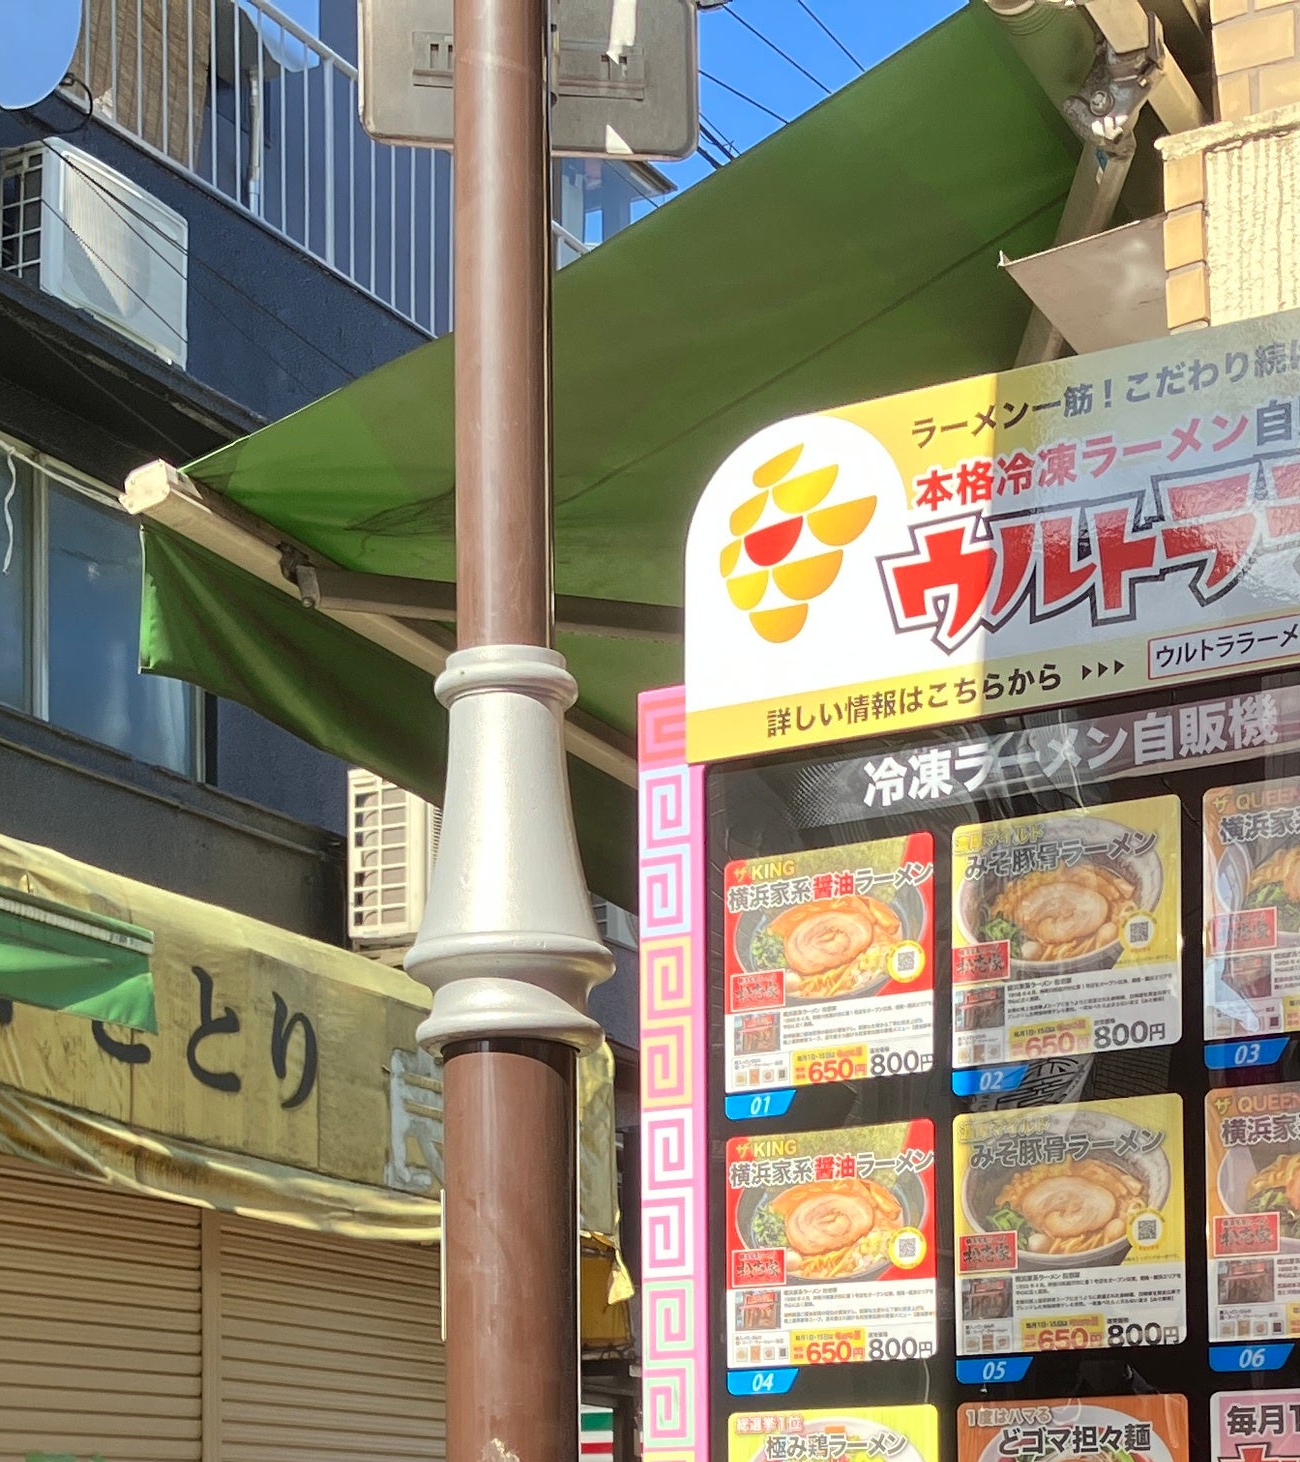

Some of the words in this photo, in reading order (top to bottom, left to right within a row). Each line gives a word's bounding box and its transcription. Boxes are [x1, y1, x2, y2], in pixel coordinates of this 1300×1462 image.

[765, 663, 1061, 738] 詳しい情報はこちらから
[863, 694, 1278, 807] 冷凍ラーメン自販機
[955, 824, 1044, 852] マイルド
[964, 831, 1158, 881] みそ豚骨ラーメン
[752, 860, 796, 881] KING
[728, 862, 934, 912] 横浜家系醤油ラーメン
[1094, 1020, 1166, 1049] 800円
[870, 1050, 934, 1076] 800円
[1234, 1044, 1260, 1065] 03
[979, 1071, 1004, 1091] 02
[750, 1096, 771, 1115] 01
[753, 1140, 797, 1158] KING
[970, 1129, 1166, 1169] みそ豚骨ラーメン
[730, 1149, 935, 1188] 横浜家系醤油ラーメン
[1107, 1322, 1179, 1347] 800円
[869, 1337, 933, 1361] 800円
[1238, 1347, 1265, 1368] 06
[752, 1372, 773, 1392] 04
[983, 1361, 1006, 1380] 05
[966, 1405, 1052, 1427] 1度はハマる
[766, 1431, 908, 1460] 極み鶏ラーメン
[998, 1422, 1152, 1456] どゴマ担々麺
